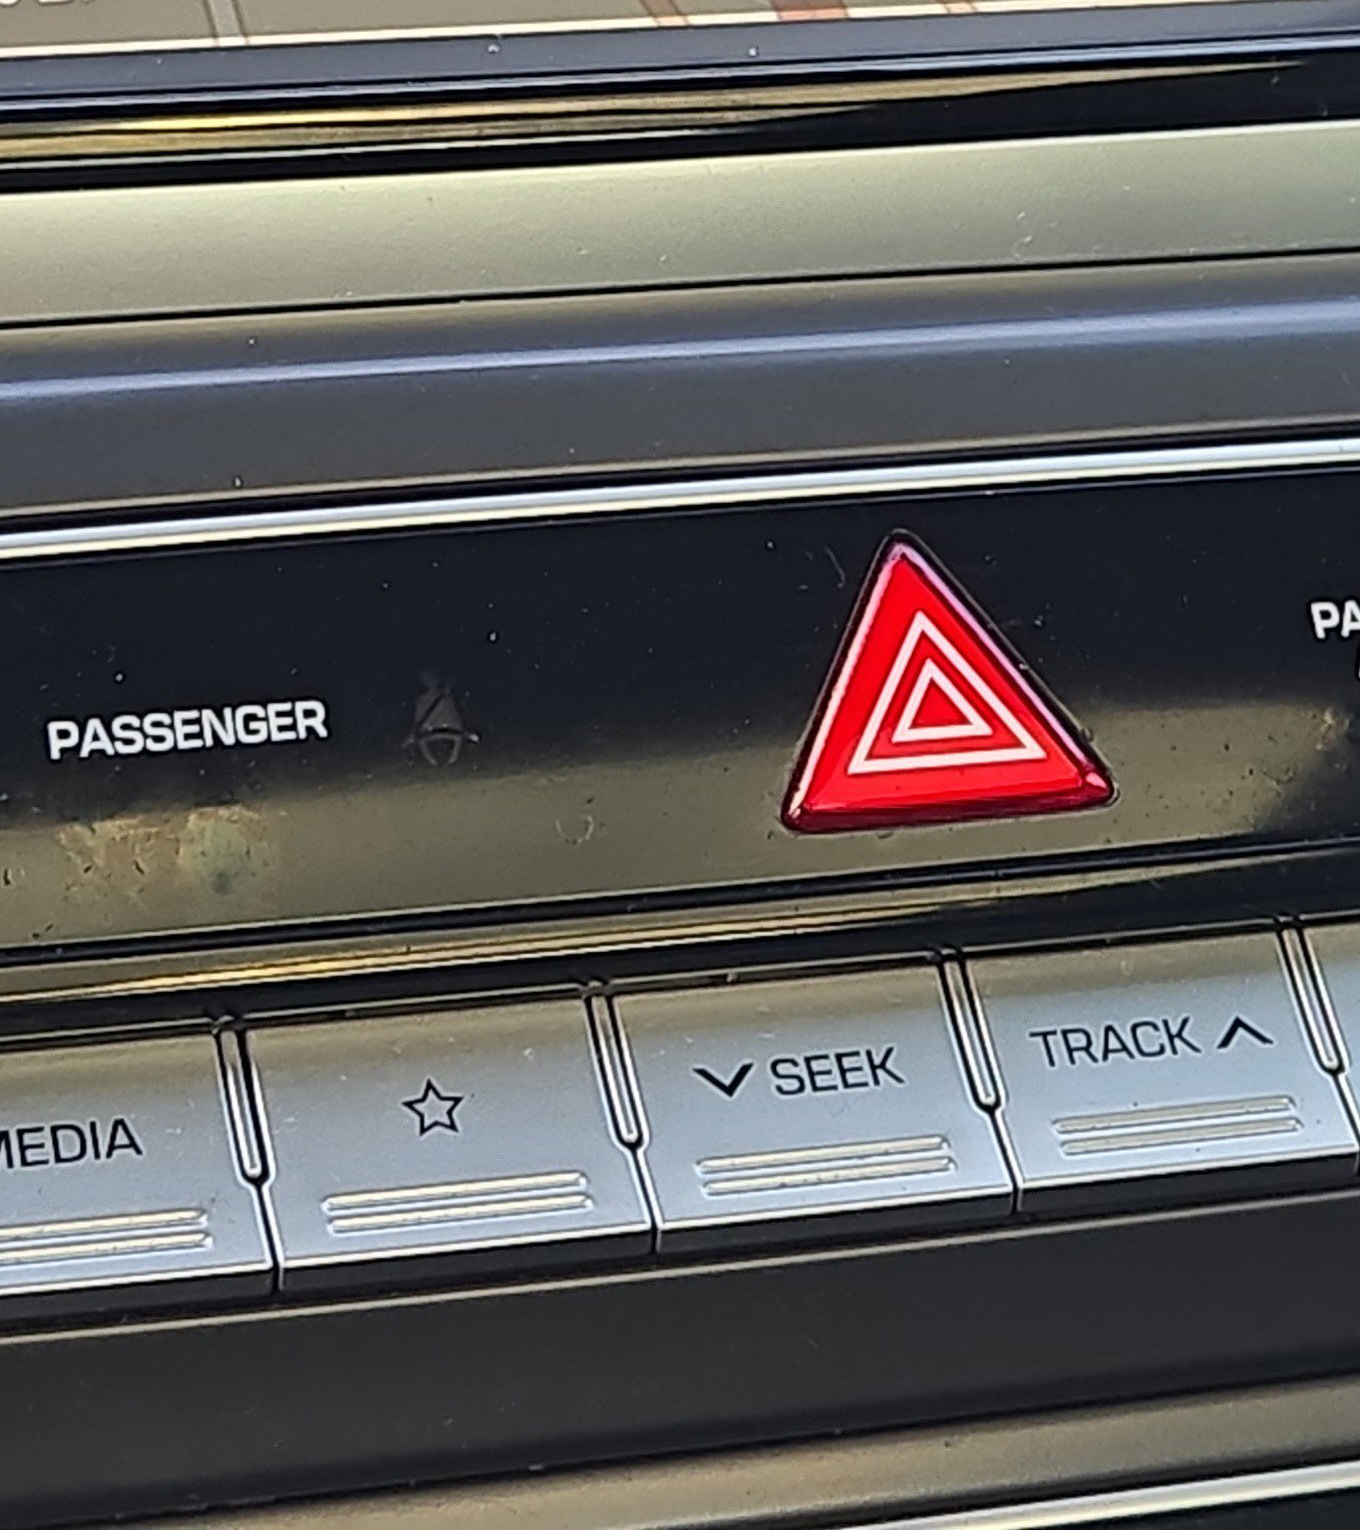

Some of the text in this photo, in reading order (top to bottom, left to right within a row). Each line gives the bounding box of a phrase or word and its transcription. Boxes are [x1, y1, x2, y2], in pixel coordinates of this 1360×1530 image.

[46, 698, 329, 761] PASSENGER
[1029, 1014, 1203, 1070] TRACK
[770, 1045, 906, 1097] SEEK
